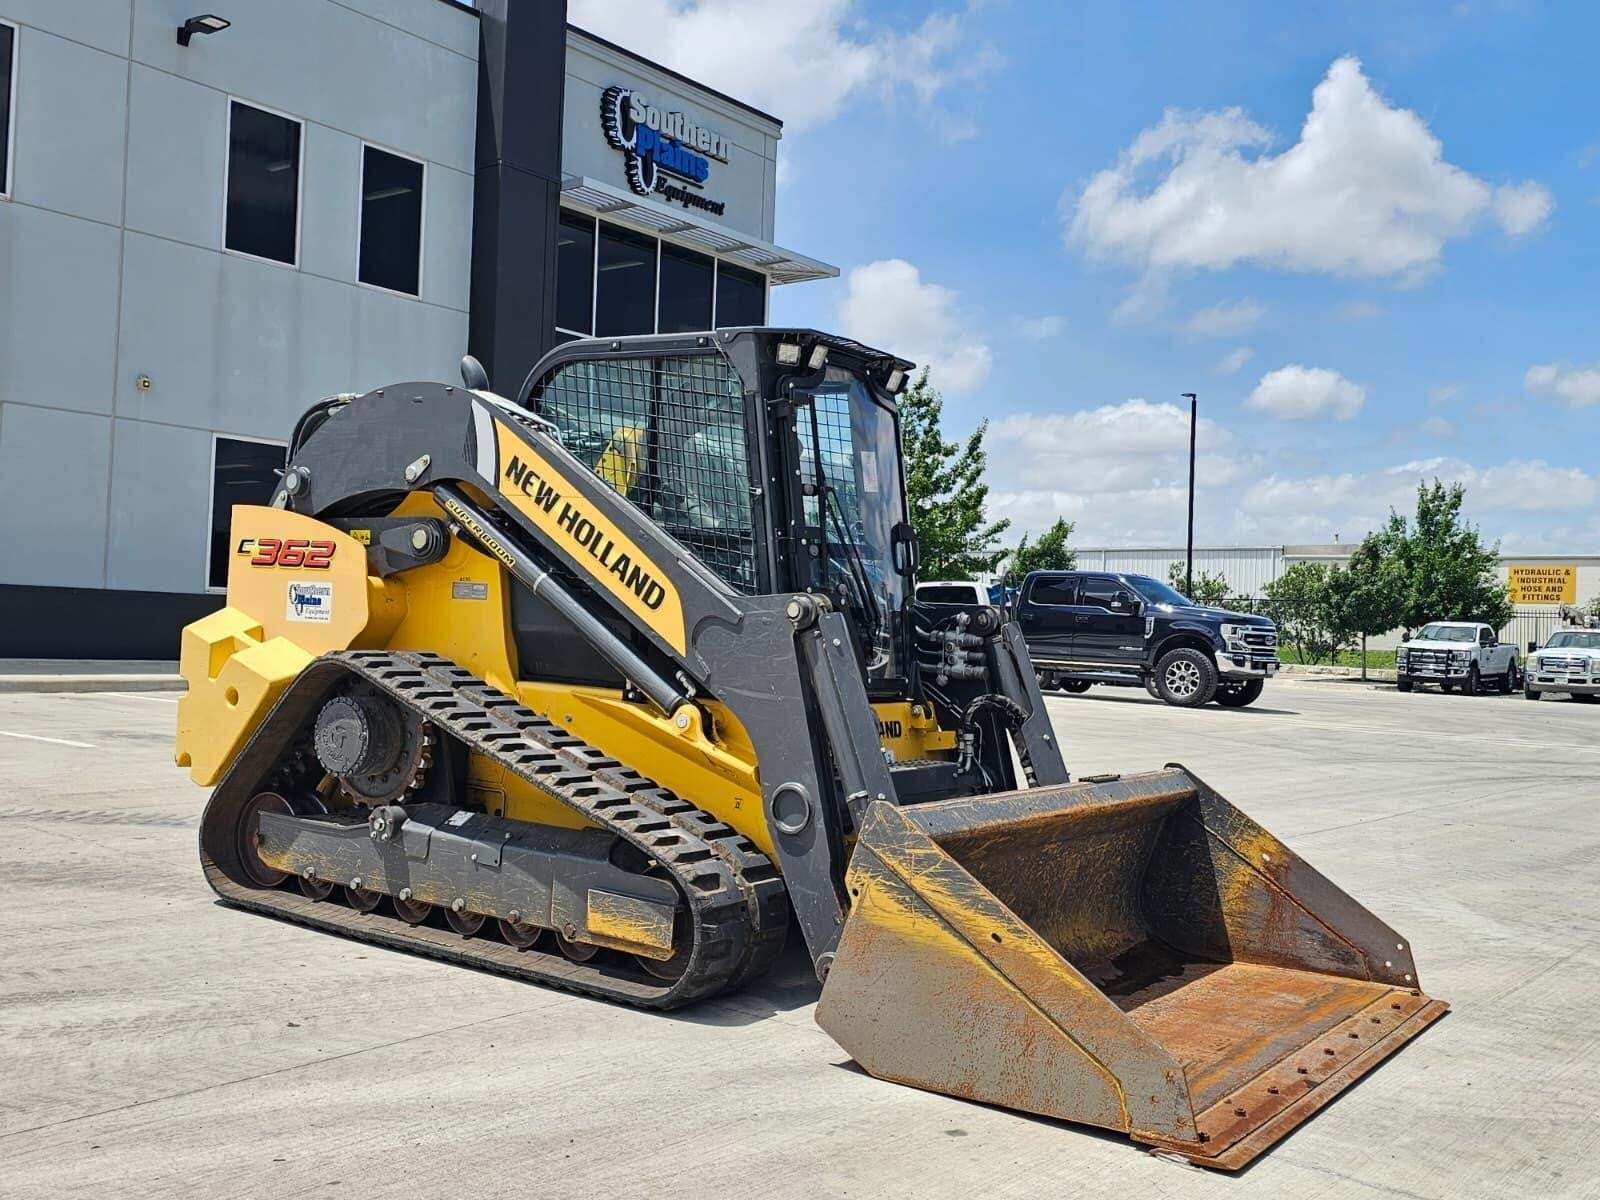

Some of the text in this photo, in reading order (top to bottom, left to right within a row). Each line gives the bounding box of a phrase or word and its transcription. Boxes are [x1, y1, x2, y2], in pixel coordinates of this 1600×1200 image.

[629, 90, 729, 160] Southern
[635, 123, 711, 184] Plains
[655, 174, 726, 217] Equipment
[445, 498, 516, 567] SUPER BOOM
[504, 455, 666, 611] NEW HOLLAND
[1513, 568, 1571, 576] HYDRAULIC &
[1520, 585, 1544, 593] HOSE
[1522, 593, 1561, 601] FITTINGS
